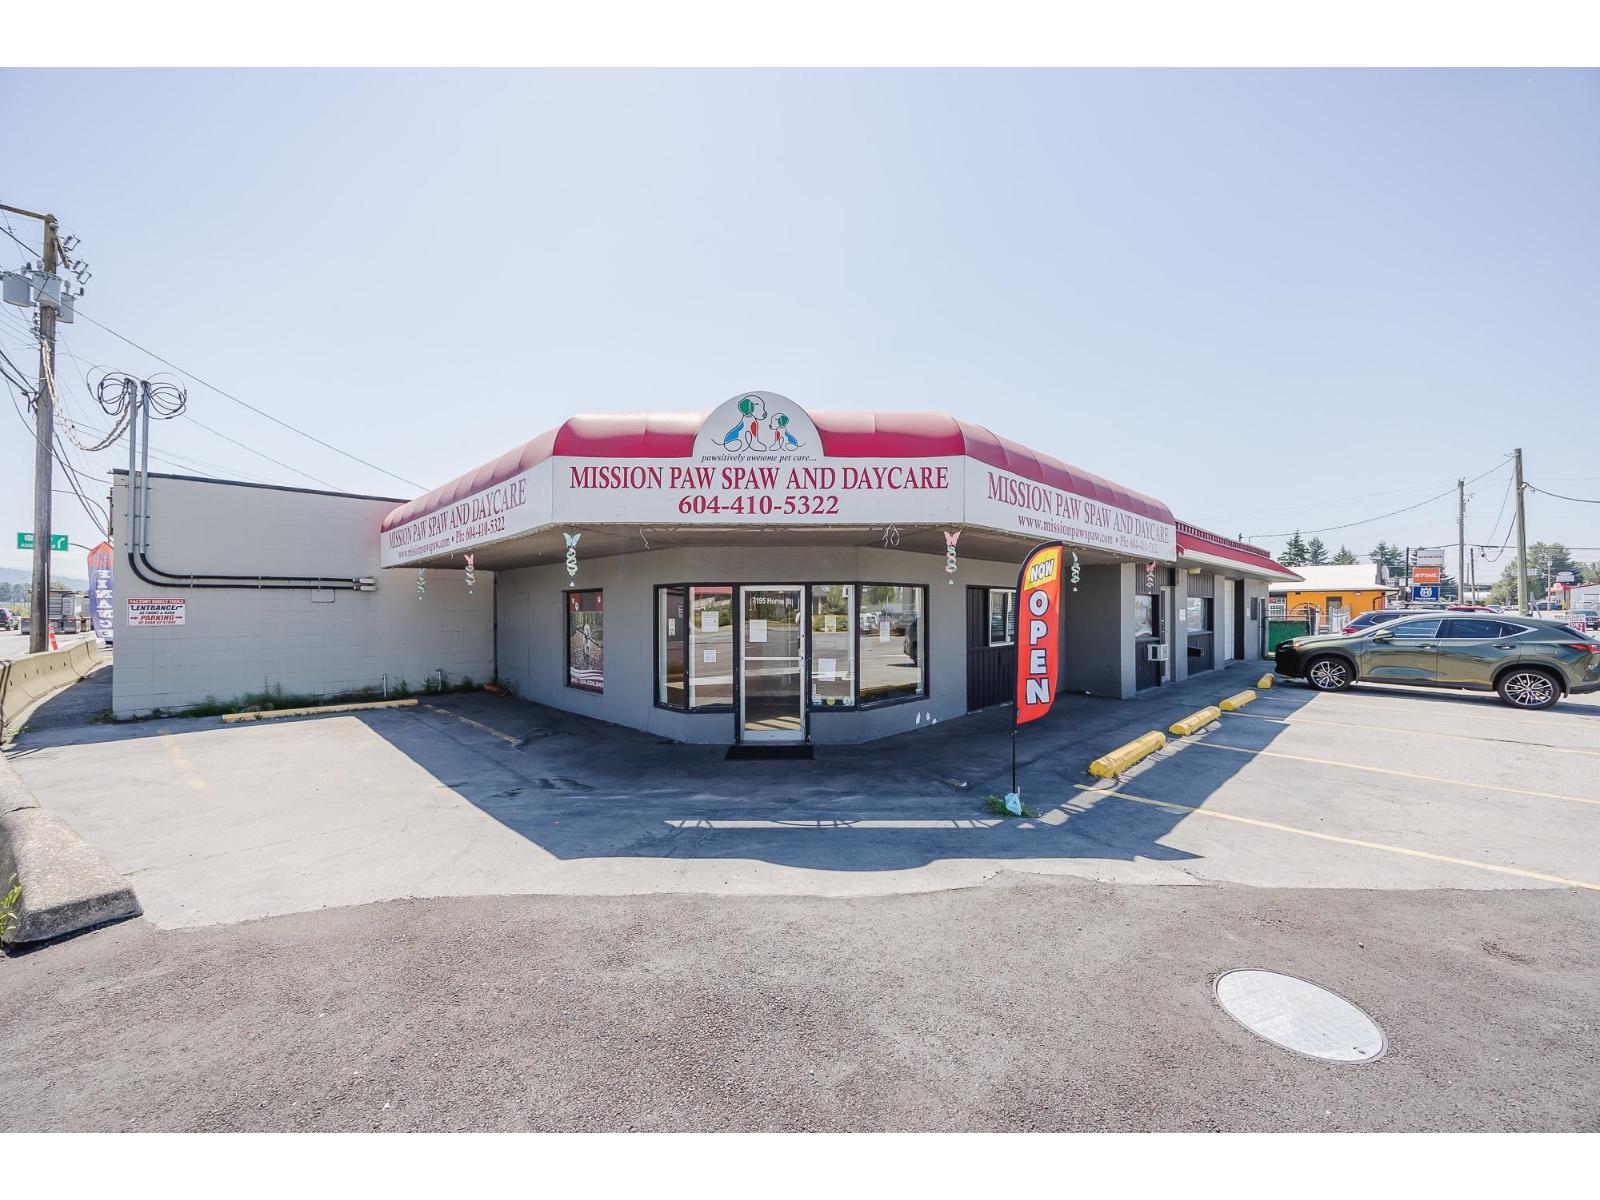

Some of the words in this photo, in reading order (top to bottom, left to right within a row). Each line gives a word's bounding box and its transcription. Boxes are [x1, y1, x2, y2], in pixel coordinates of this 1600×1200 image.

[701, 453, 745, 463] pawsitively
[779, 454, 792, 463] pet
[569, 466, 664, 490] MISSION
[668, 466, 717, 490] PAW
[722, 466, 780, 490] SPAW
[786, 466, 837, 490] AND
[841, 466, 949, 490] DAYCARE
[389, 526, 412, 549] MISSION
[413, 519, 427, 543] PAW
[428, 511, 449, 538] SPAW
[449, 502, 470, 530] AND
[471, 478, 527, 523] DAYCARE
[678, 495, 839, 515] 604-410-5322
[987, 471, 1053, 515] MISSION
[1056, 492, 1082, 520] PAW
[1084, 502, 1111, 529] SPAW
[1113, 511, 1133, 535] AND
[1134, 517, 1169, 544] DAYCARE
[1018, 515, 1113, 545] www.missionpawspaw.com
[1030, 558, 1055, 584] NOW
[752, 596, 766, 605] 7195
[1026, 589, 1051, 706] OPEN
